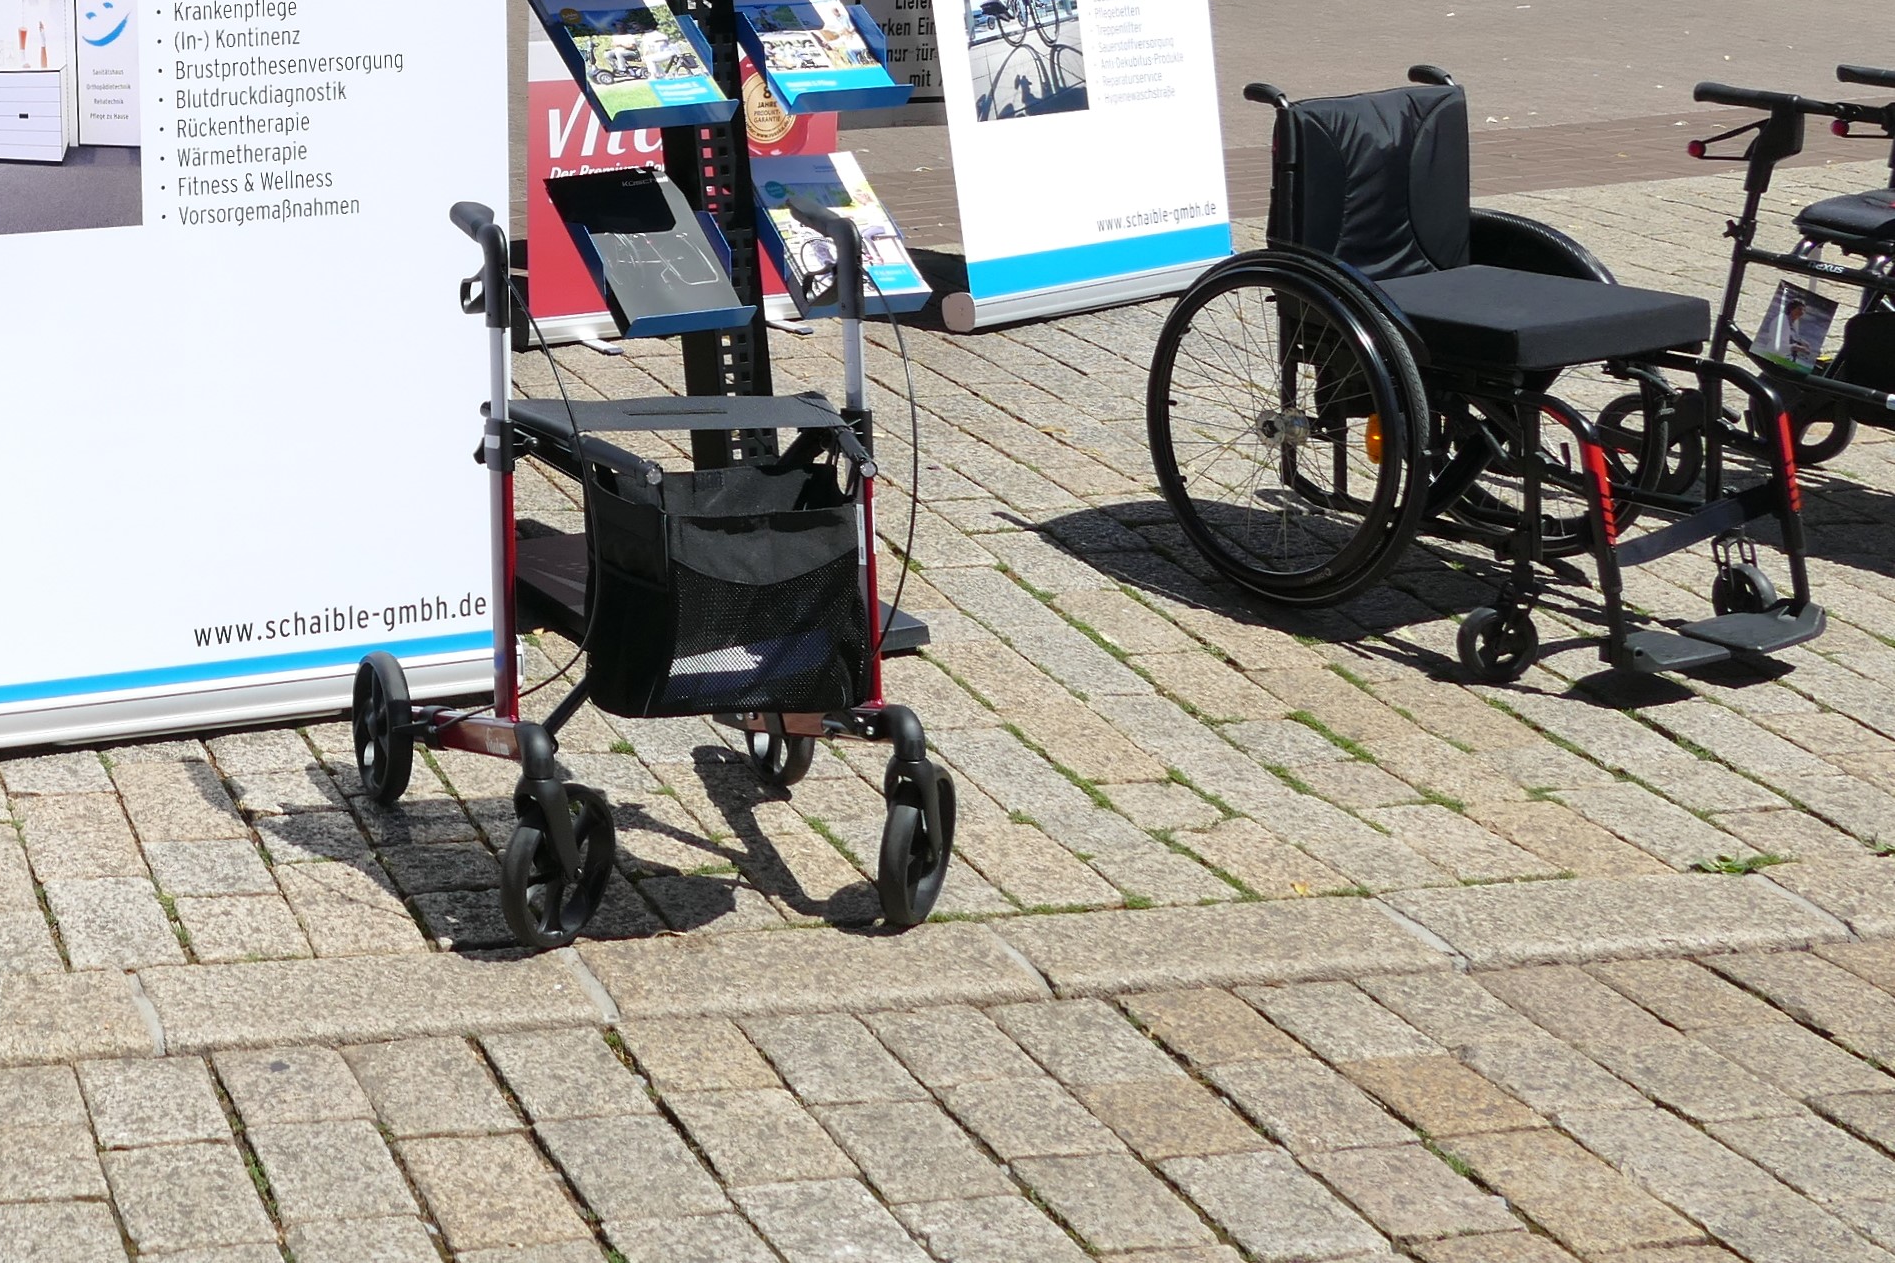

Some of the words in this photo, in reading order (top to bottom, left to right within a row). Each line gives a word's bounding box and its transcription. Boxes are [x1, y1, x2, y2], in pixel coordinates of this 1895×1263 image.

[174, 30, 210, 54] (In-)
[215, 27, 301, 49] Kontinenz
[175, 53, 404, 82] Brustprothesenversorgung
[176, 81, 347, 109] Blutdruckdiagnostik
[177, 111, 310, 139] Rückentherapie
[176, 140, 308, 168] Wärmetherapie
[178, 176, 239, 197] Fitness
[244, 172, 255, 193] &
[260, 169, 333, 191] Wellness
[178, 197, 360, 227] Vorsorgemaßnahmen
[1096, 200, 1217, 232] www.schaible-gmbh.de
[194, 592, 487, 648] www.schaible-gmbh.de
